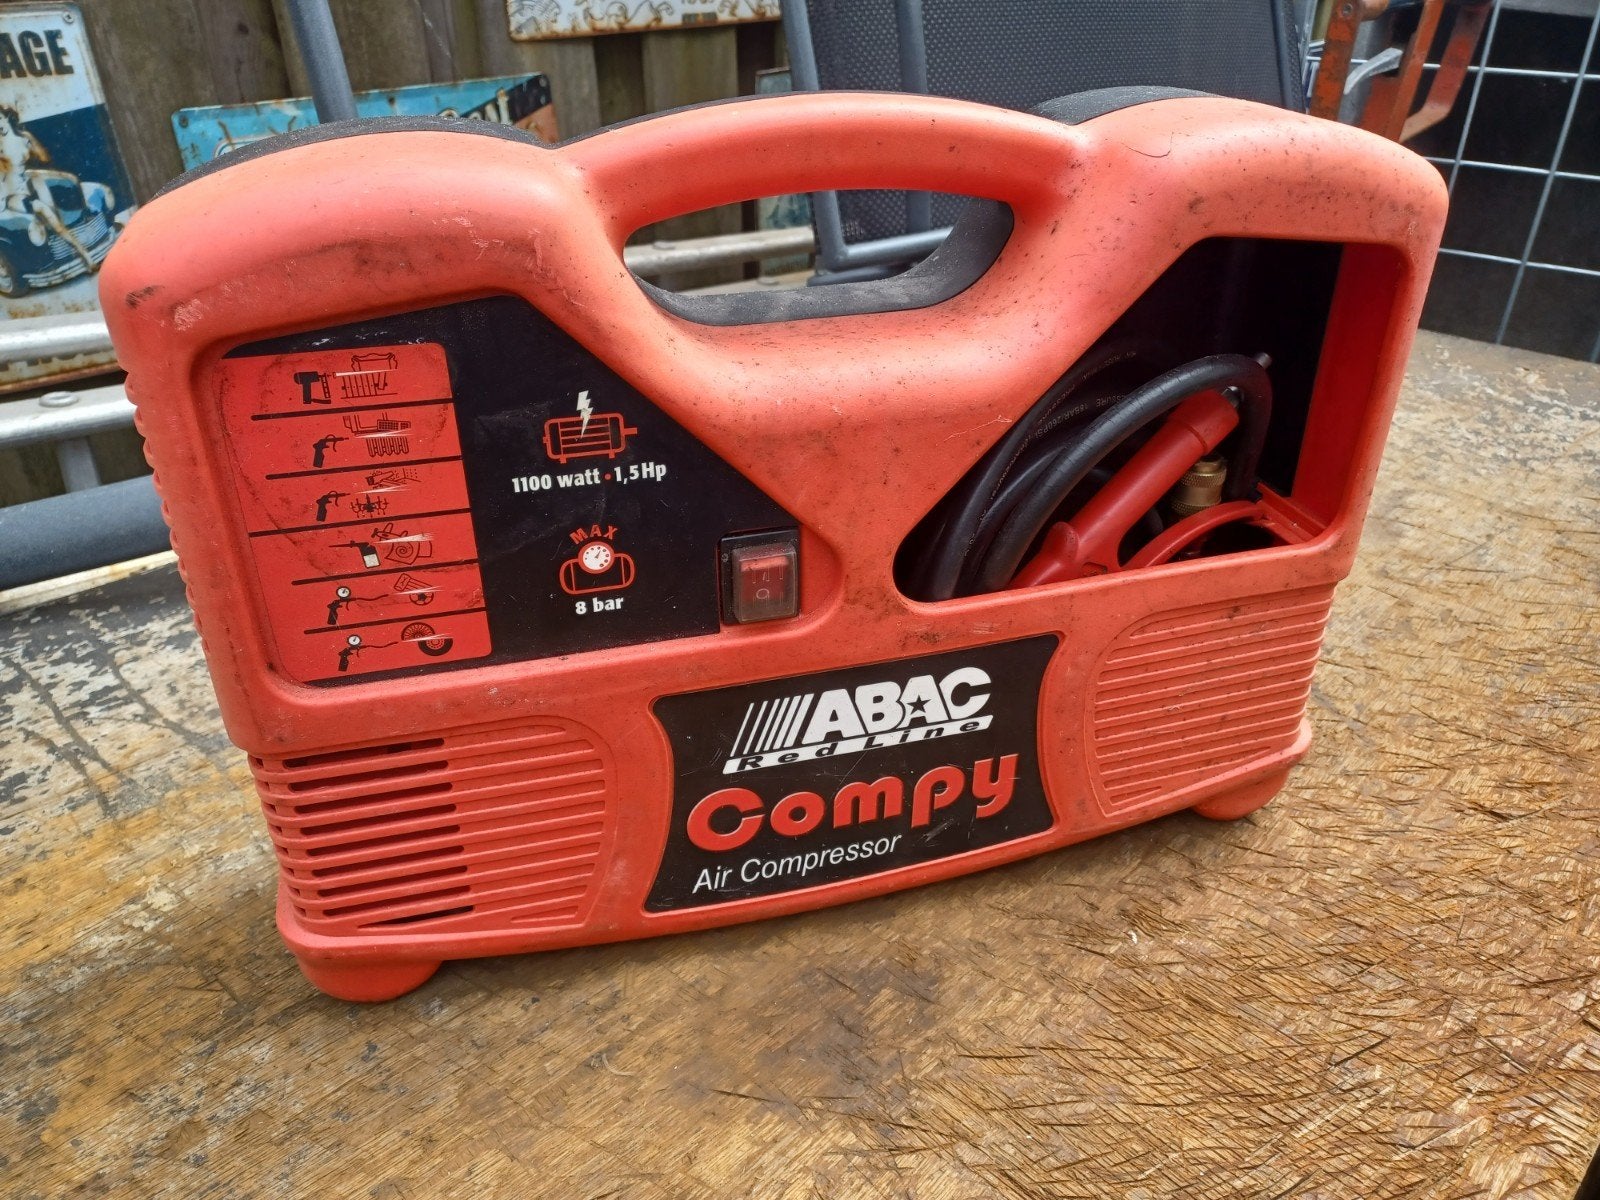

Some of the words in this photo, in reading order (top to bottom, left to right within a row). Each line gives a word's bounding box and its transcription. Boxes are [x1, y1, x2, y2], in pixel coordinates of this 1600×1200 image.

[511, 474, 552, 493] 1100
[557, 467, 600, 486] watt
[569, 525, 617, 544] MAX
[575, 601, 587, 615] 8
[593, 596, 624, 613] bar
[802, 667, 992, 746] ABAC
[736, 742, 840, 772] Red
[862, 719, 982, 750] Line
[686, 753, 1019, 852] Compy
[692, 858, 734, 894] Air
[740, 833, 903, 879] Compressor
